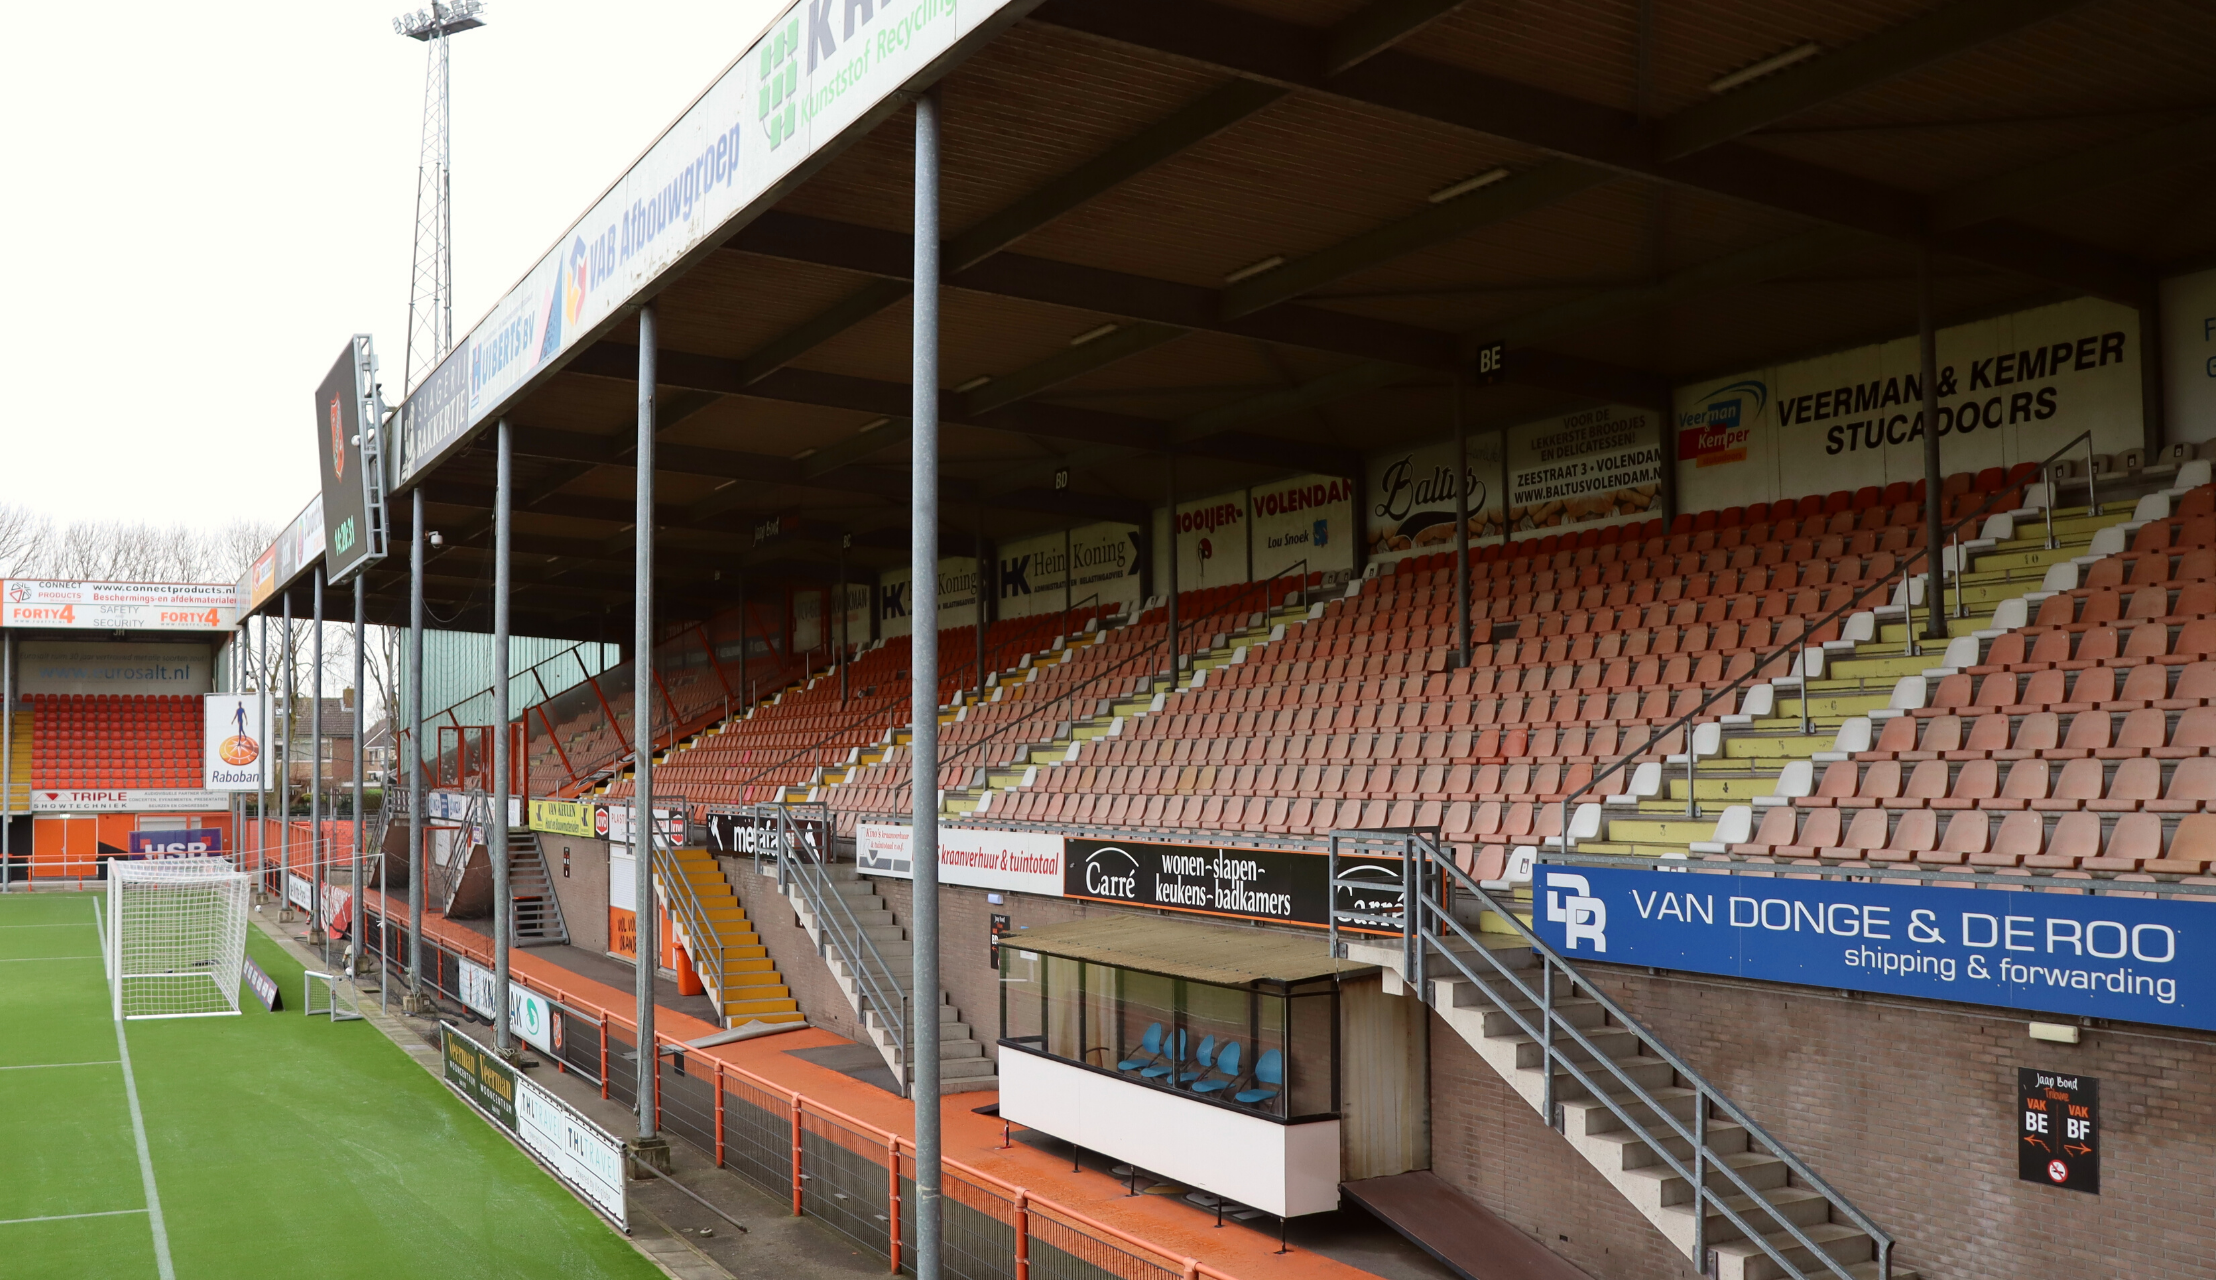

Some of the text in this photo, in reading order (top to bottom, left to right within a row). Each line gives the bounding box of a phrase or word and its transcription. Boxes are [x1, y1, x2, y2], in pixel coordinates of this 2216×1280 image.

[801, 38, 871, 127] Kunststof
[589, 121, 741, 292] VAB Afbouwgroep
[471, 315, 521, 397] HUIBERTS
[523, 310, 535, 351] BV
[1480, 345, 1502, 374] BE
[418, 353, 467, 423] SLAGERIJ
[1778, 330, 2127, 427] VEERMAN & KEMPER
[416, 388, 466, 460] BAKKERTJE
[1563, 408, 1610, 429] VOOR DE
[1679, 405, 1737, 428] Veerman
[1825, 386, 2058, 455] STUCADOORS
[1531, 415, 1646, 450] LEKKERSTE BROODJES
[1698, 429, 1750, 449] Kemper
[1541, 432, 1636, 462] EN DELICATESSEN!
[1055, 470, 1068, 490] BD
[1517, 462, 1578, 488] ZEESTRAAT
[1580, 462, 1588, 477] 3
[1268, 530, 1309, 549] Lou Snoek
[1001, 537, 1126, 599] HK Hein Koning
[2024, 553, 2039, 565] 10
[39, 581, 82, 589] CONNECT
[93, 584, 236, 594] www.connectproducts.nl
[100, 605, 140, 614] SAFETY
[882, 581, 906, 620] HK
[14, 604, 75, 624] FORTY4
[93, 618, 145, 627] SECURITY
[160, 608, 220, 627] FORTY4
[39, 664, 191, 680] www.eurosalt.nl
[212, 770, 260, 783] Raboban
[1722, 782, 1729, 793] 4
[71, 792, 127, 801] TRIPLE
[548, 803, 576, 818] VAN KEULEN
[941, 843, 999, 871] kraanverhuur
[1000, 849, 1009, 872] &
[1010, 852, 1059, 876] tuintotaal
[1085, 861, 1136, 899] Carré
[1632, 889, 1714, 925] VAN
[1729, 895, 1891, 940] DONGE
[1907, 908, 1946, 943] &
[1845, 945, 2177, 1004] shipping & forwarding
[448, 1032, 475, 1075] Veerman
[479, 1053, 511, 1102] Veerman
[2035, 1073, 2079, 1091] Jaap Bond
[2027, 1098, 2047, 1111] VAK
[2068, 1104, 2089, 1118] VAK
[2025, 1111, 2049, 1134] BE
[2067, 1117, 2091, 1140] BF
